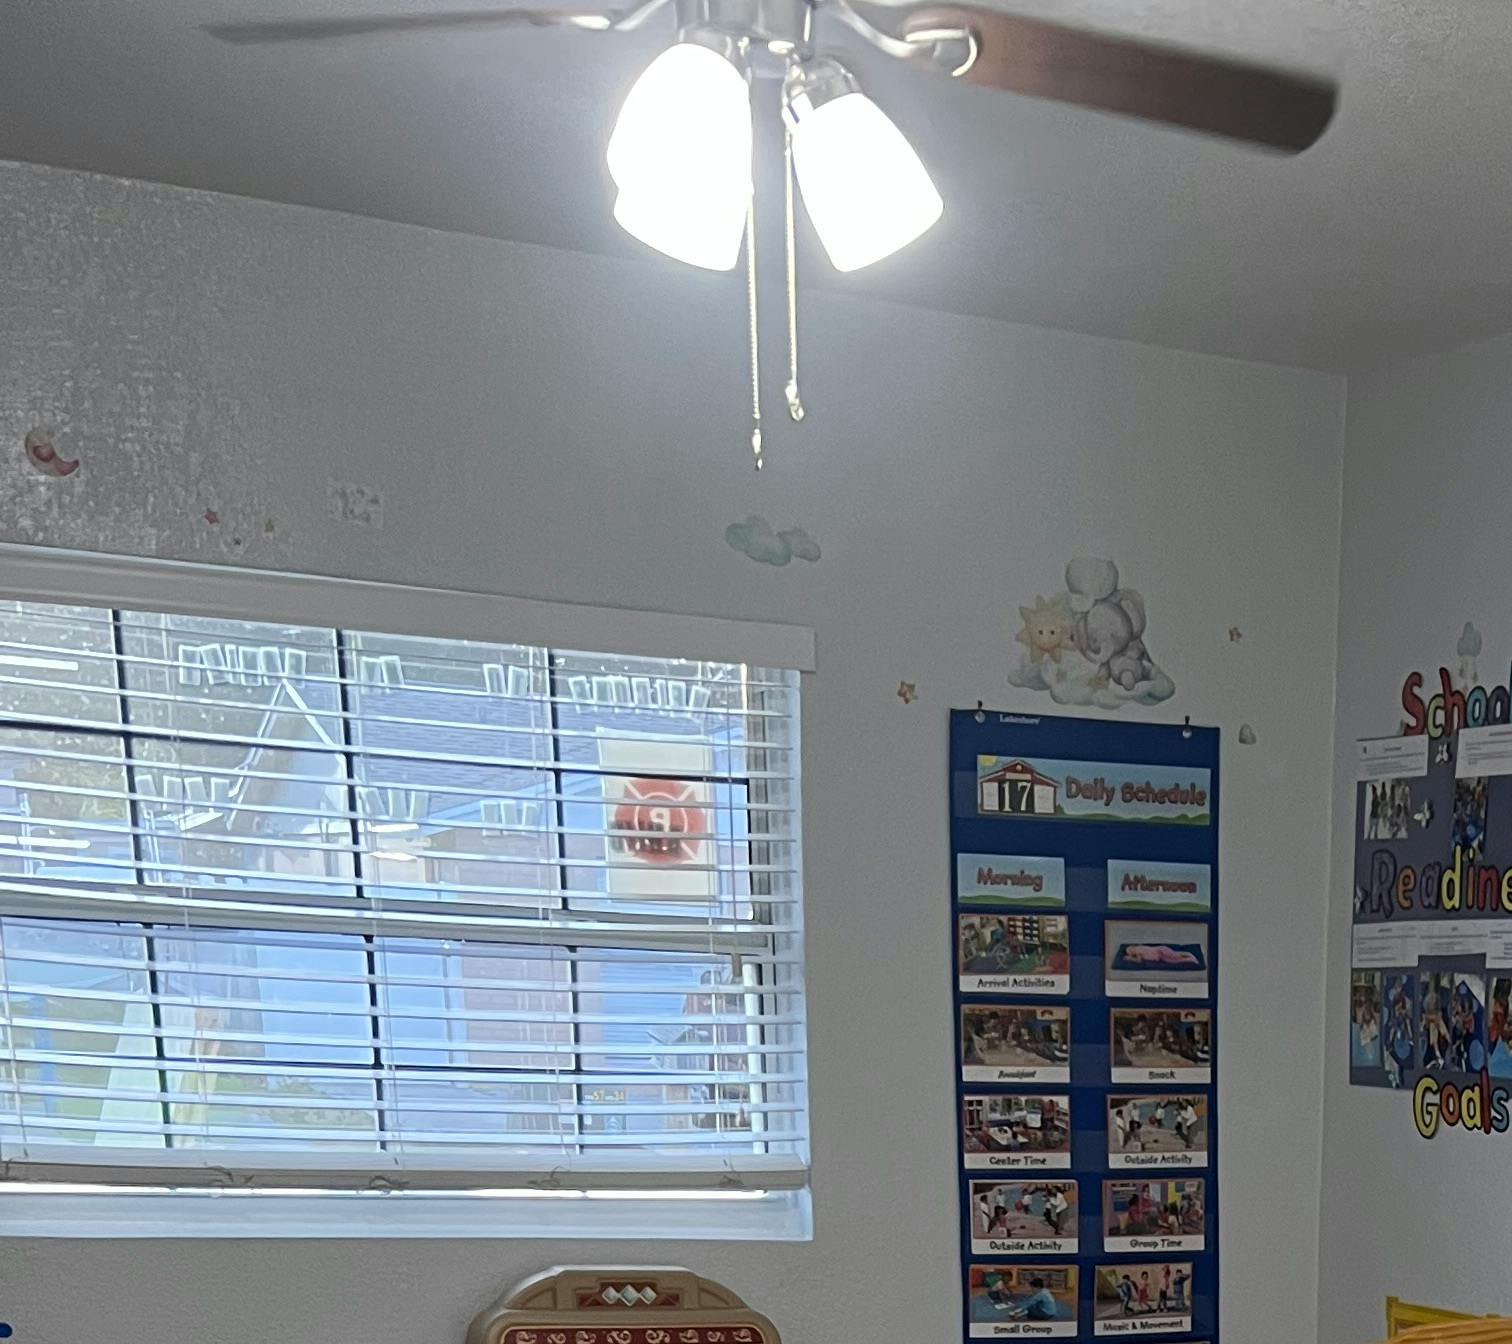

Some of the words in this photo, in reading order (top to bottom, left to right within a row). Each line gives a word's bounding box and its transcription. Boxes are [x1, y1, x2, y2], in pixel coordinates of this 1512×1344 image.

[1002, 780, 1031, 812] 17
[1066, 776, 1115, 806] Daily
[1121, 781, 1207, 807] Schedule
[976, 867, 1043, 891] Morning
[1121, 873, 1197, 894] Afternoon
[977, 977, 1010, 988] Arrival
[1011, 977, 1055, 988] Activities
[1139, 983, 1178, 994] Naptime
[1149, 1070, 1176, 1080] Snack
[1413, 1066, 1510, 1139] Goals
[989, 1156, 1021, 1166] Center
[1024, 1155, 1047, 1165] Time
[1125, 1155, 1158, 1165] Outside
[1160, 1155, 1192, 1165] Activity
[990, 1241, 1024, 1251] Outside
[1027, 1240, 1062, 1251] Activity
[1130, 1239, 1158, 1249] Group
[1161, 1238, 1182, 1248] Time
[994, 1325, 1020, 1334] Small
[1023, 1324, 1052, 1334] Group
[1103, 1322, 1130, 1332] Music
[1132, 1321, 1137, 1330] &
[1140, 1319, 1184, 1330] Movement
